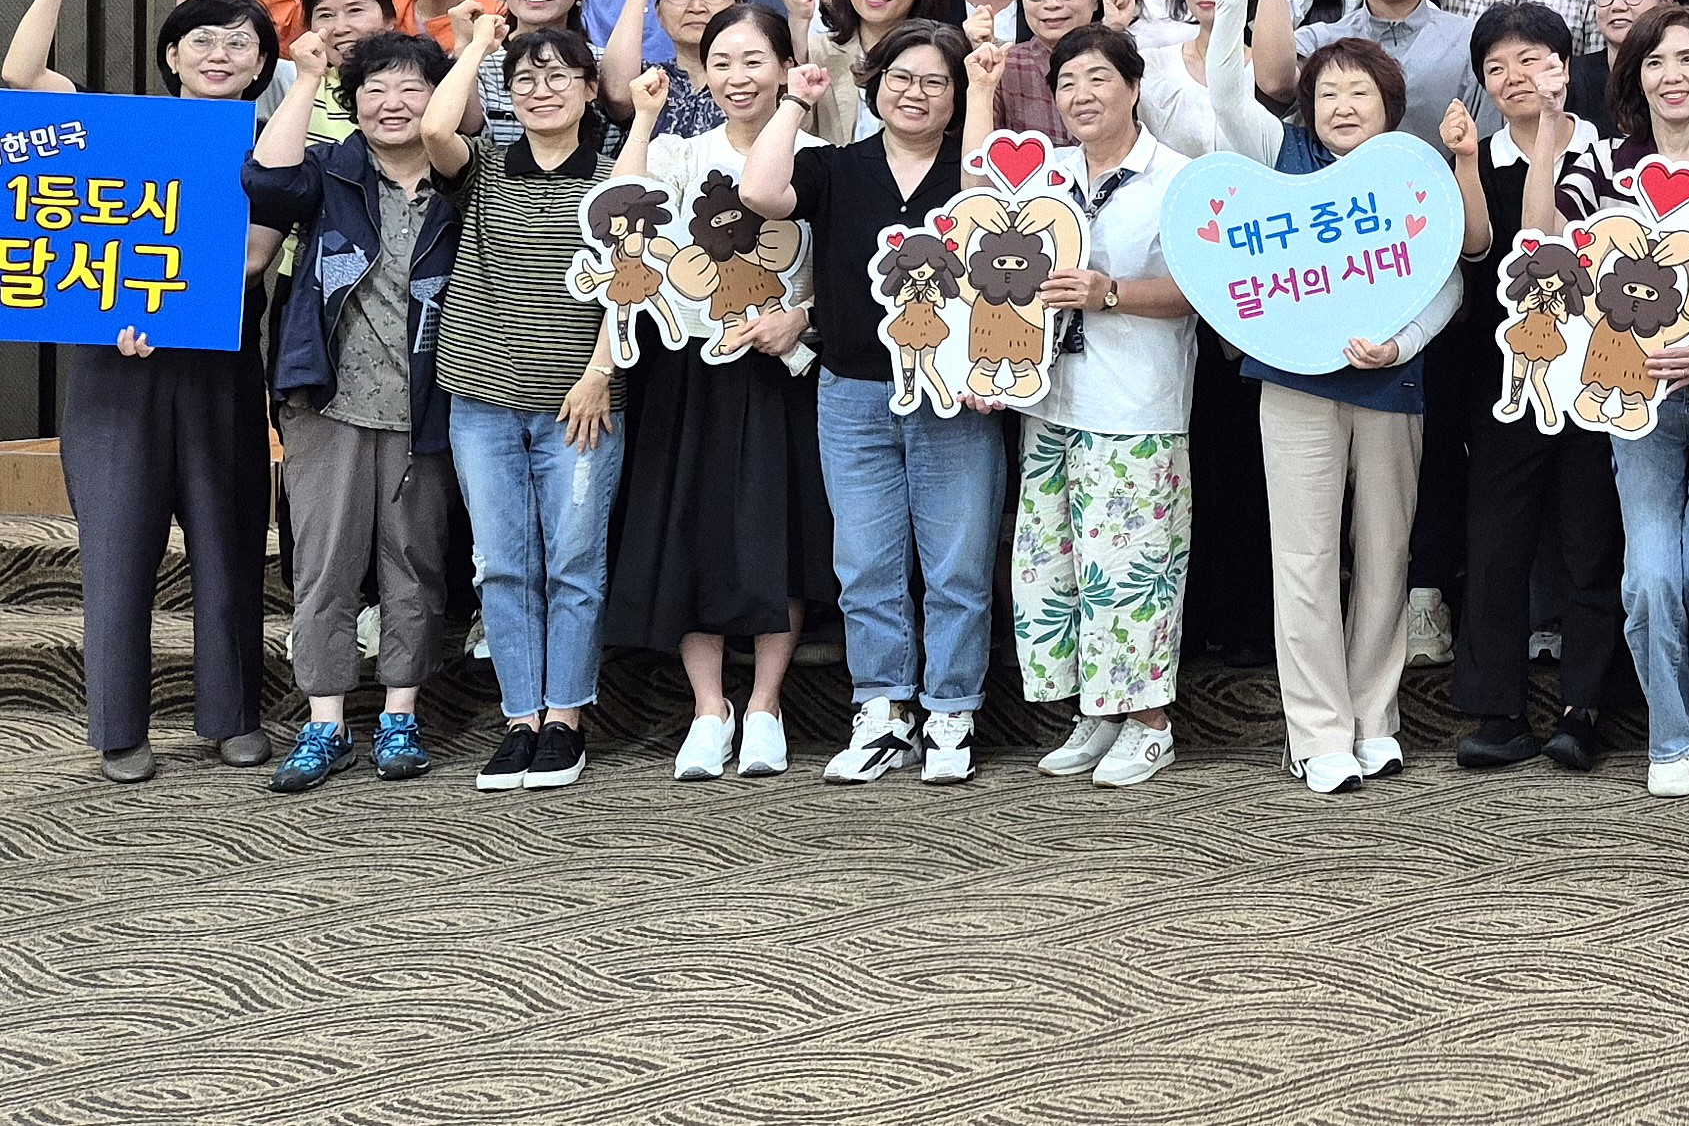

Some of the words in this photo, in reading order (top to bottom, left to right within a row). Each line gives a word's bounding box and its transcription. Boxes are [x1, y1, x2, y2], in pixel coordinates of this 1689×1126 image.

[0, 120, 87, 165] 한민국
[7, 174, 181, 235] 1등도시
[1227, 212, 1300, 256] 대구
[1309, 191, 1392, 244] 중심,
[0, 237, 188, 314] 달서구
[1228, 265, 1331, 320] 달서의
[1341, 240, 1412, 285] 시대
